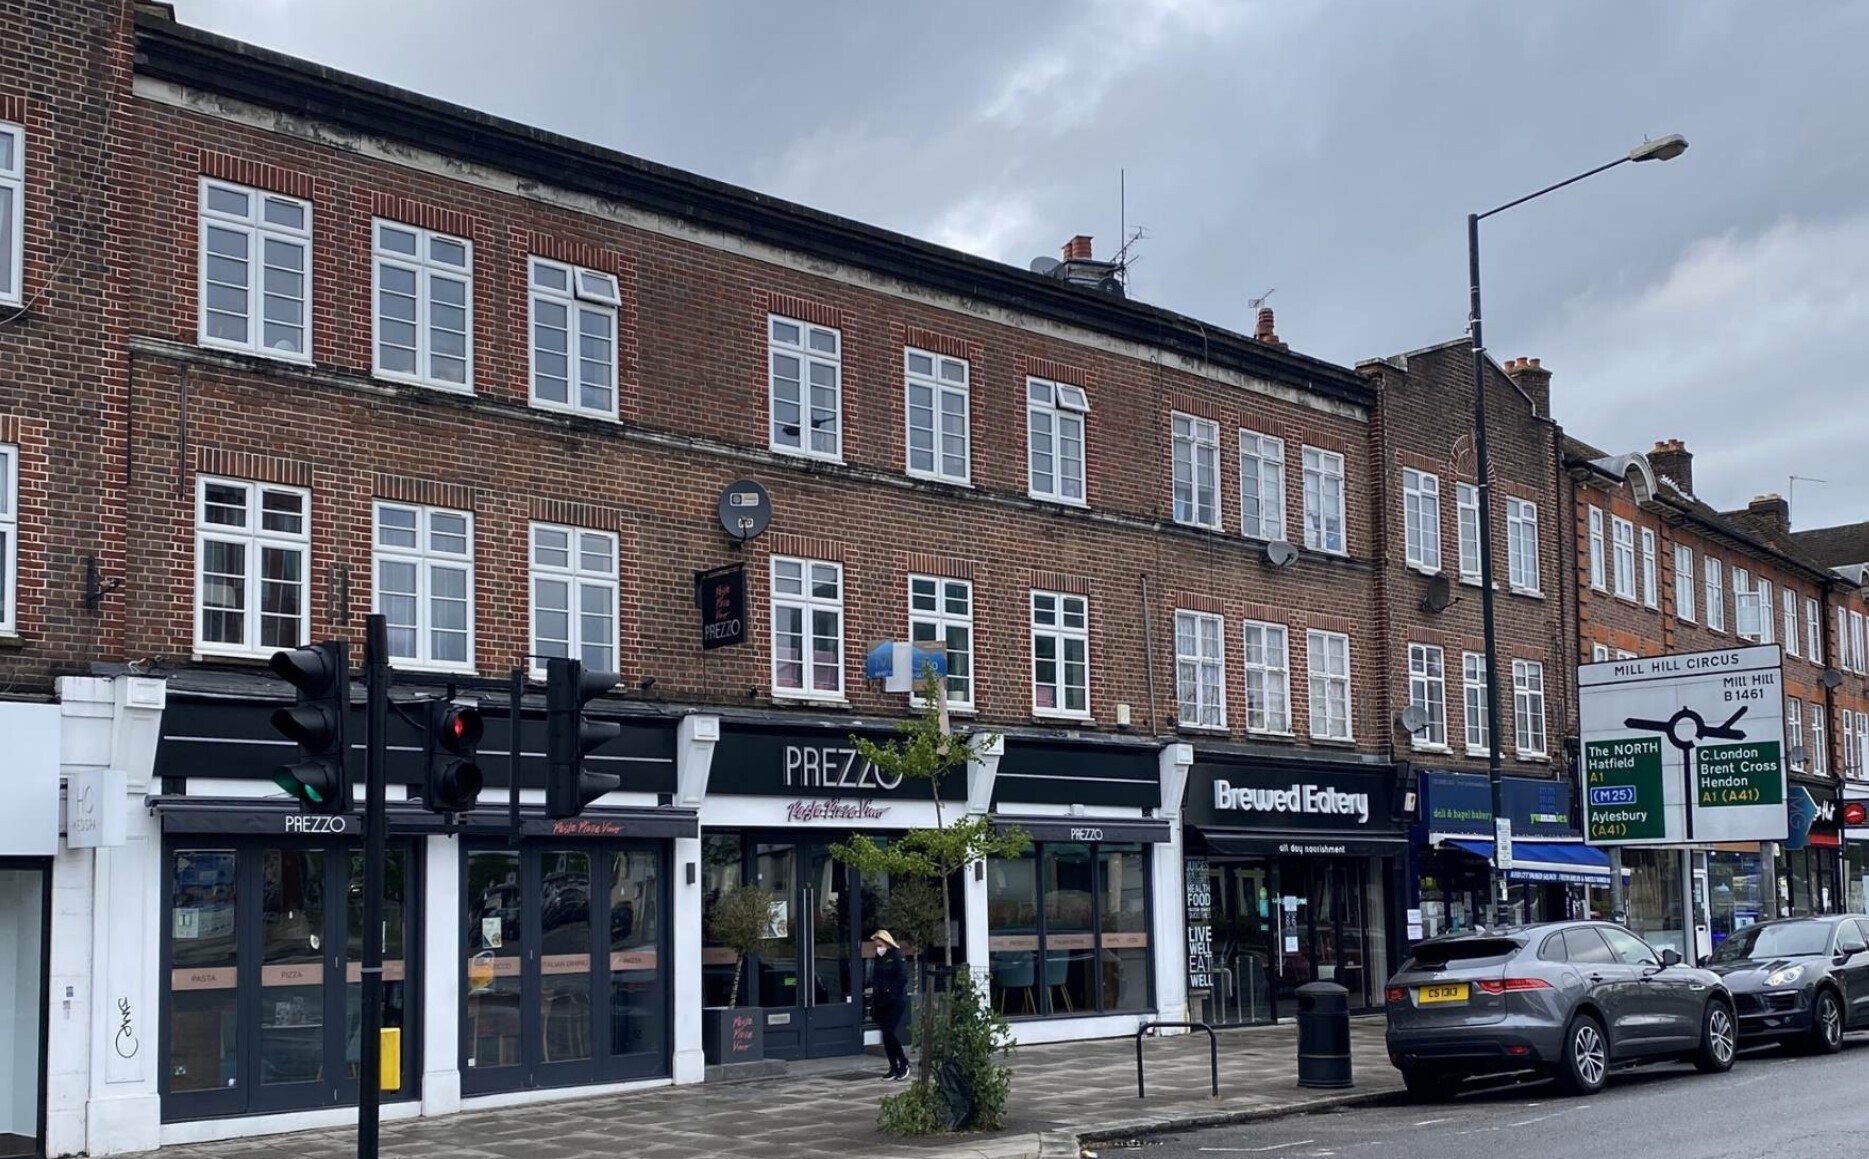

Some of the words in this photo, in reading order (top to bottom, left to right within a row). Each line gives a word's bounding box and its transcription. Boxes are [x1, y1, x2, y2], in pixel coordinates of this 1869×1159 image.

[705, 619, 740, 640] PREZZO
[1615, 664, 1644, 676] MILL
[1652, 660, 1680, 673] HILL
[1687, 654, 1739, 669] CIRCUS
[1723, 676, 1746, 688] Mill
[1752, 674, 1774, 686] Hill
[1589, 746, 1609, 758] The
[1614, 742, 1658, 755] NORTH
[785, 745, 904, 790] PREZZO
[1589, 757, 1635, 770] Hatfield
[1701, 762, 1735, 775] Brent
[1740, 761, 1777, 772] Cross
[1590, 772, 1604, 782] A1
[1701, 776, 1748, 788] Hendon
[1214, 779, 1300, 812] Brewed
[1302, 785, 1369, 823] Eatery
[1593, 788, 1633, 803] (M25)
[1703, 791, 1717, 802] A1
[1722, 788, 1760, 803] (A41)
[1433, 808, 1446, 818] deli
[1591, 810, 1648, 823] Aylesbury
[285, 815, 346, 833] PREZZO
[1592, 823, 1627, 836] (A41)
[1071, 828, 1103, 841] PREZZO
[1279, 843, 1288, 852] all
[1290, 843, 1303, 855] day
[1305, 844, 1345, 854] nourishment
[1187, 884, 1210, 893] HEALTH
[1188, 893, 1211, 906] FOOD
[1189, 926, 1212, 942] LIVE
[1190, 942, 1212, 955] WELL
[1190, 955, 1212, 973] EAT
[191, 974, 216, 983] PASTA
[281, 971, 303, 979] PIZZA
[1191, 973, 1214, 987] WELL
